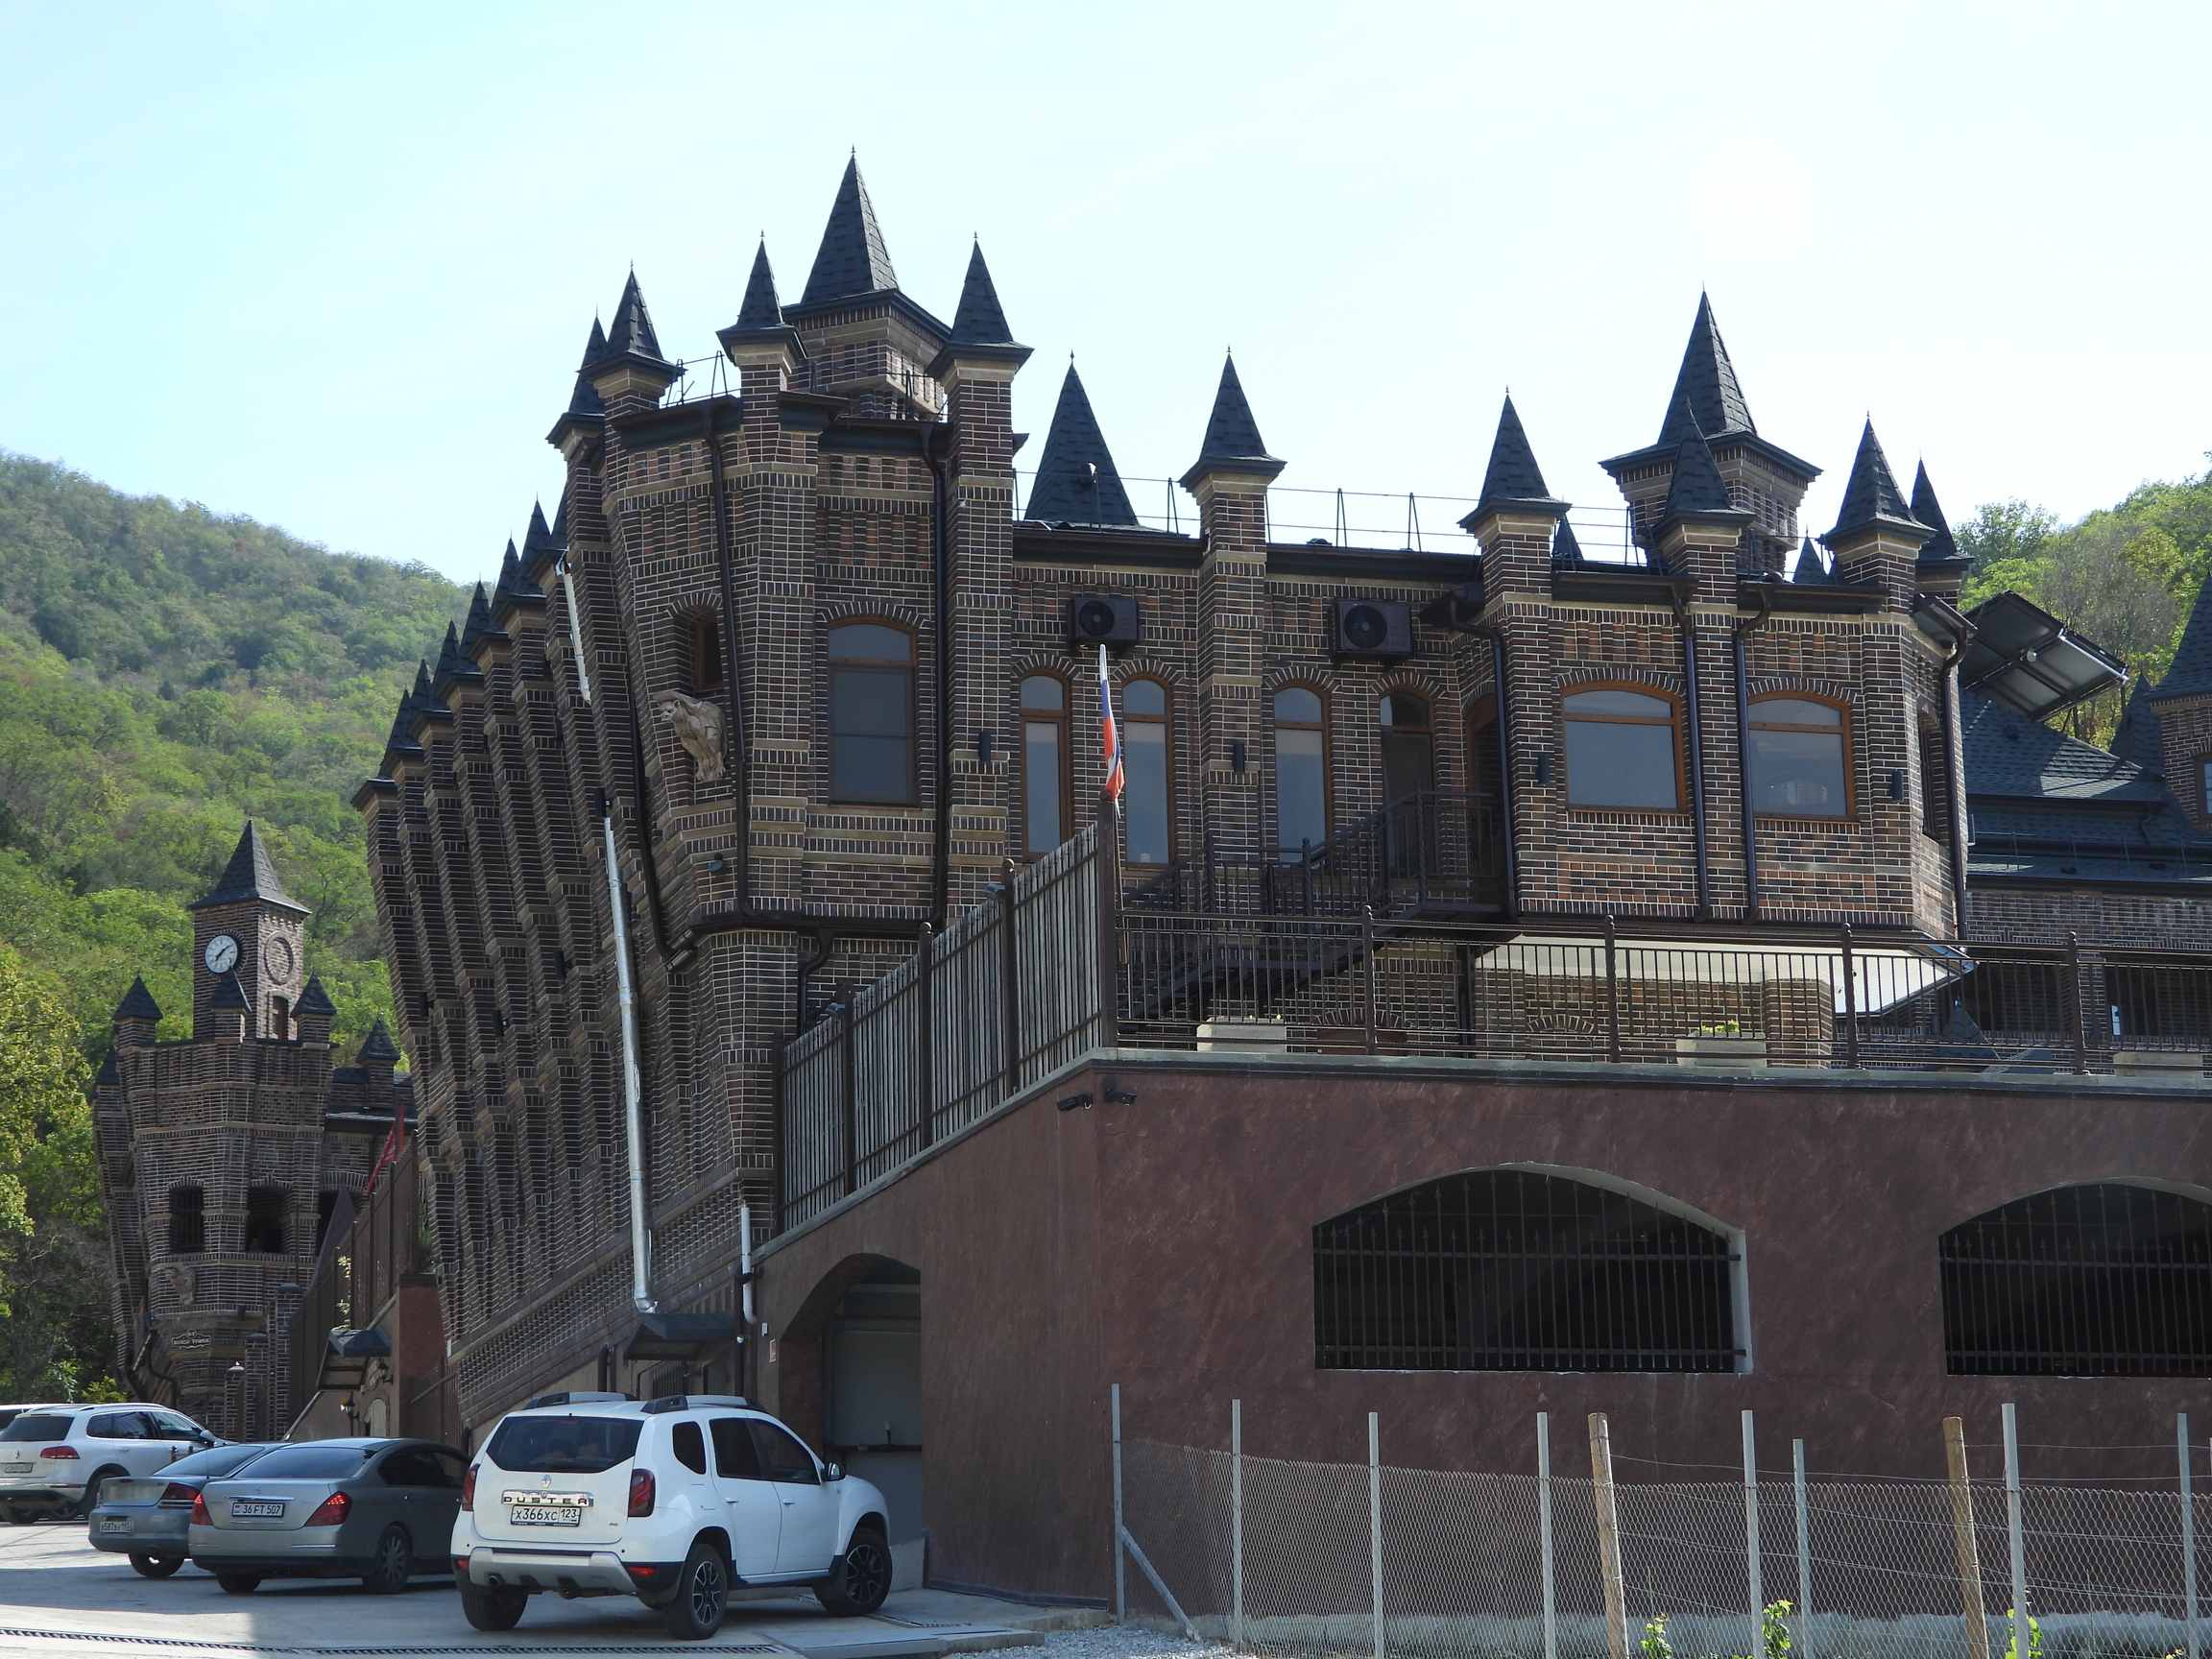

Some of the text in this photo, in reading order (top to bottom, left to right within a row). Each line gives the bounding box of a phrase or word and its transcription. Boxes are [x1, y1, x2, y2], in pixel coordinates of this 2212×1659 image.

[503, 1496, 588, 1505] DUSTER
[243, 1504, 252, 1514] 36
[266, 1504, 281, 1514] 507
[560, 1508, 577, 1519] 123
